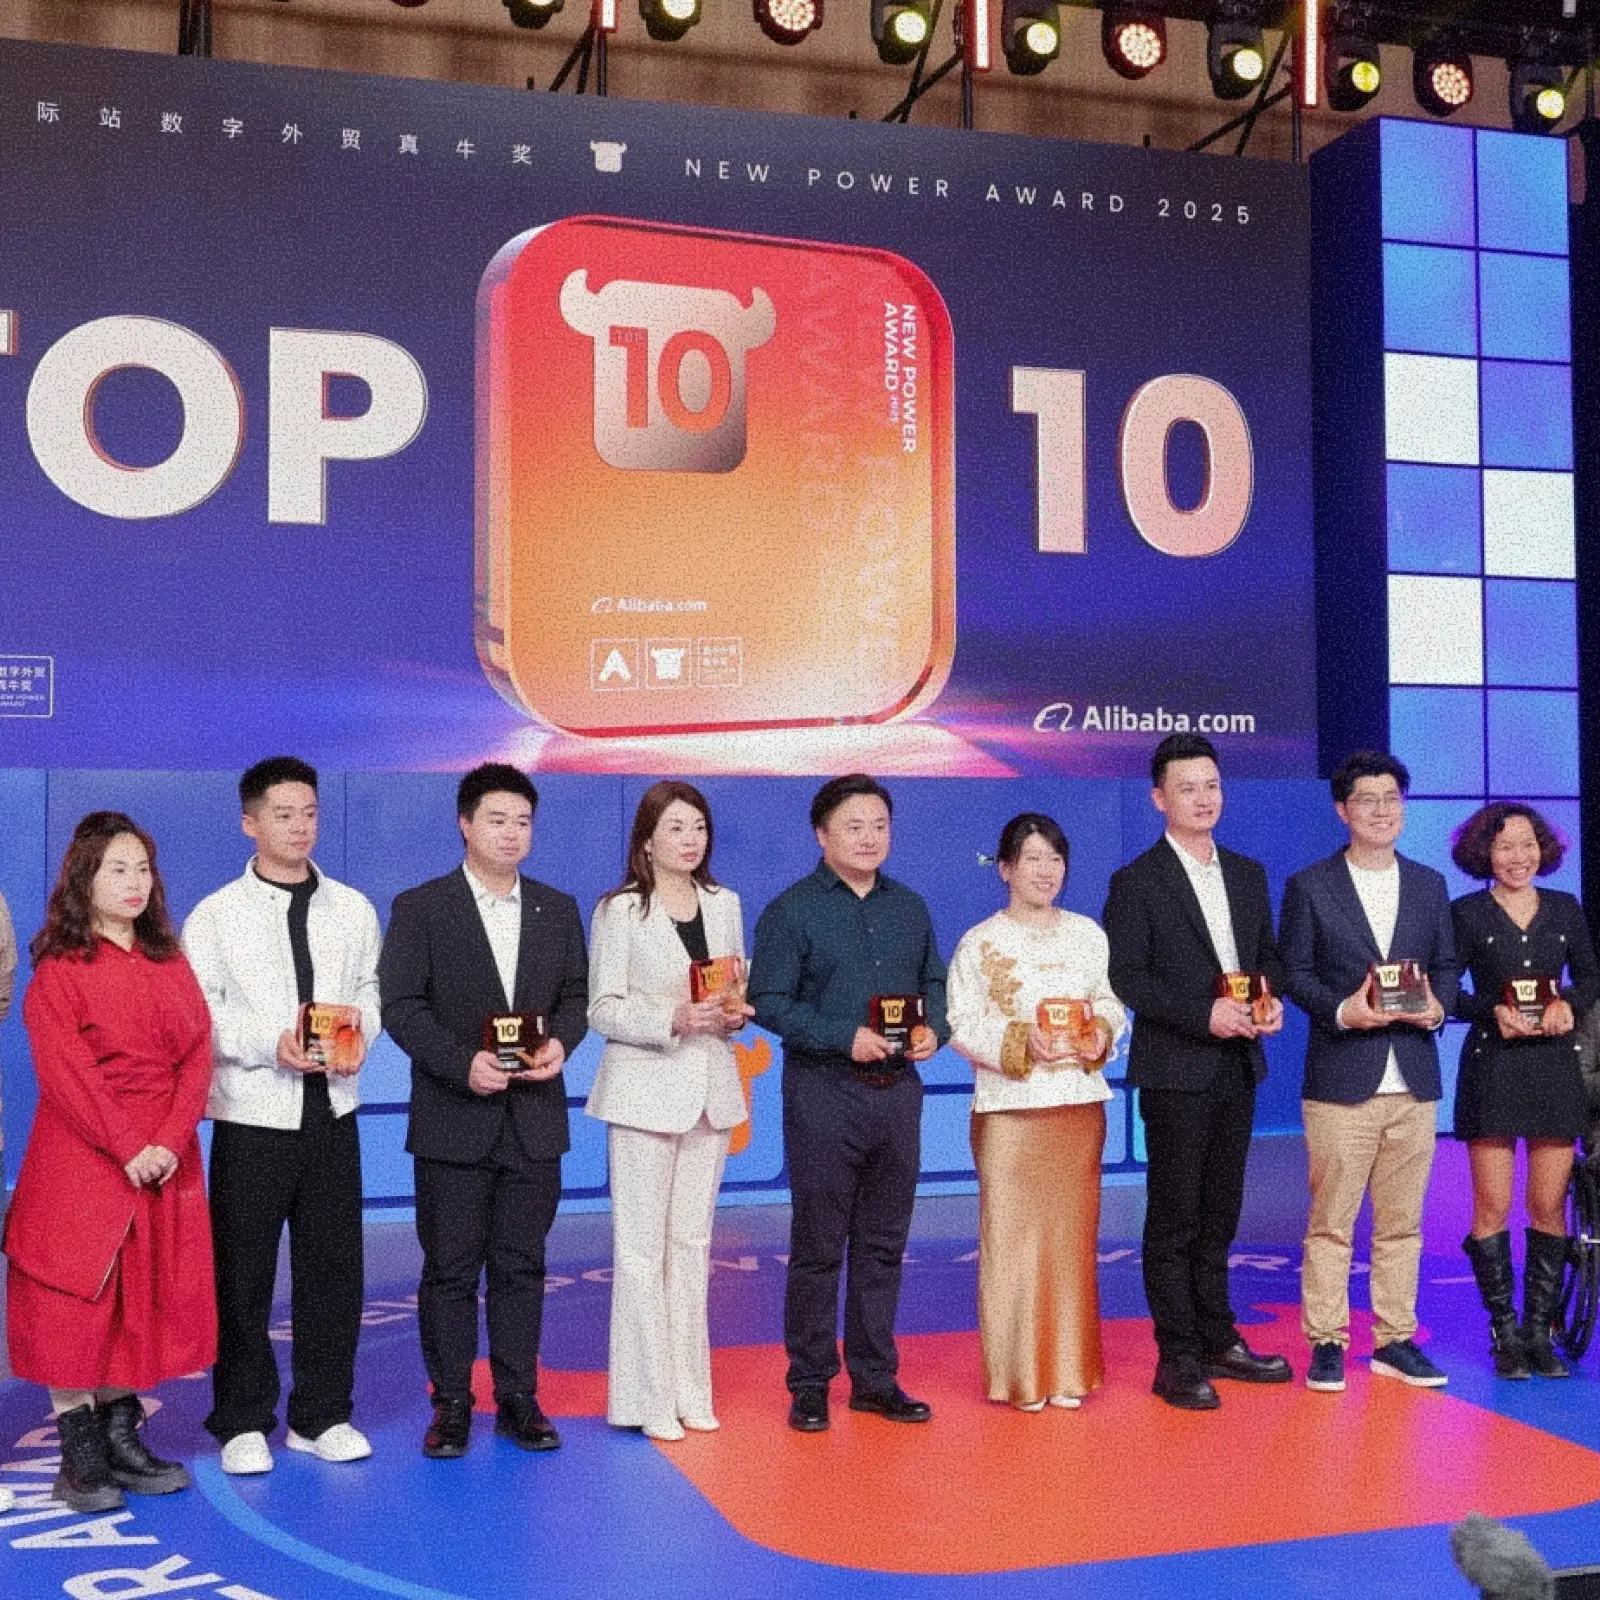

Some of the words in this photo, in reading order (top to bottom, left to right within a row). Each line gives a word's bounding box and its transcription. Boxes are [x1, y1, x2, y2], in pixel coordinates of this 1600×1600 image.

[36, 100, 533, 165] 际站数字外贸真牛奖
[684, 158, 770, 184] NEW
[807, 168, 949, 198] POWER
[984, 184, 1125, 214] AWARD
[1158, 198, 1250, 225] 2025
[884, 301, 900, 392] AWARD
[901, 303, 917, 359] NEW
[608, 324, 732, 435] 10
[902, 366, 917, 453] POWER
[0, 310, 429, 525] OP
[1009, 365, 1255, 558] 10
[1082, 705, 1255, 733] Alibaba.com
[499, 1023, 517, 1038] 10
